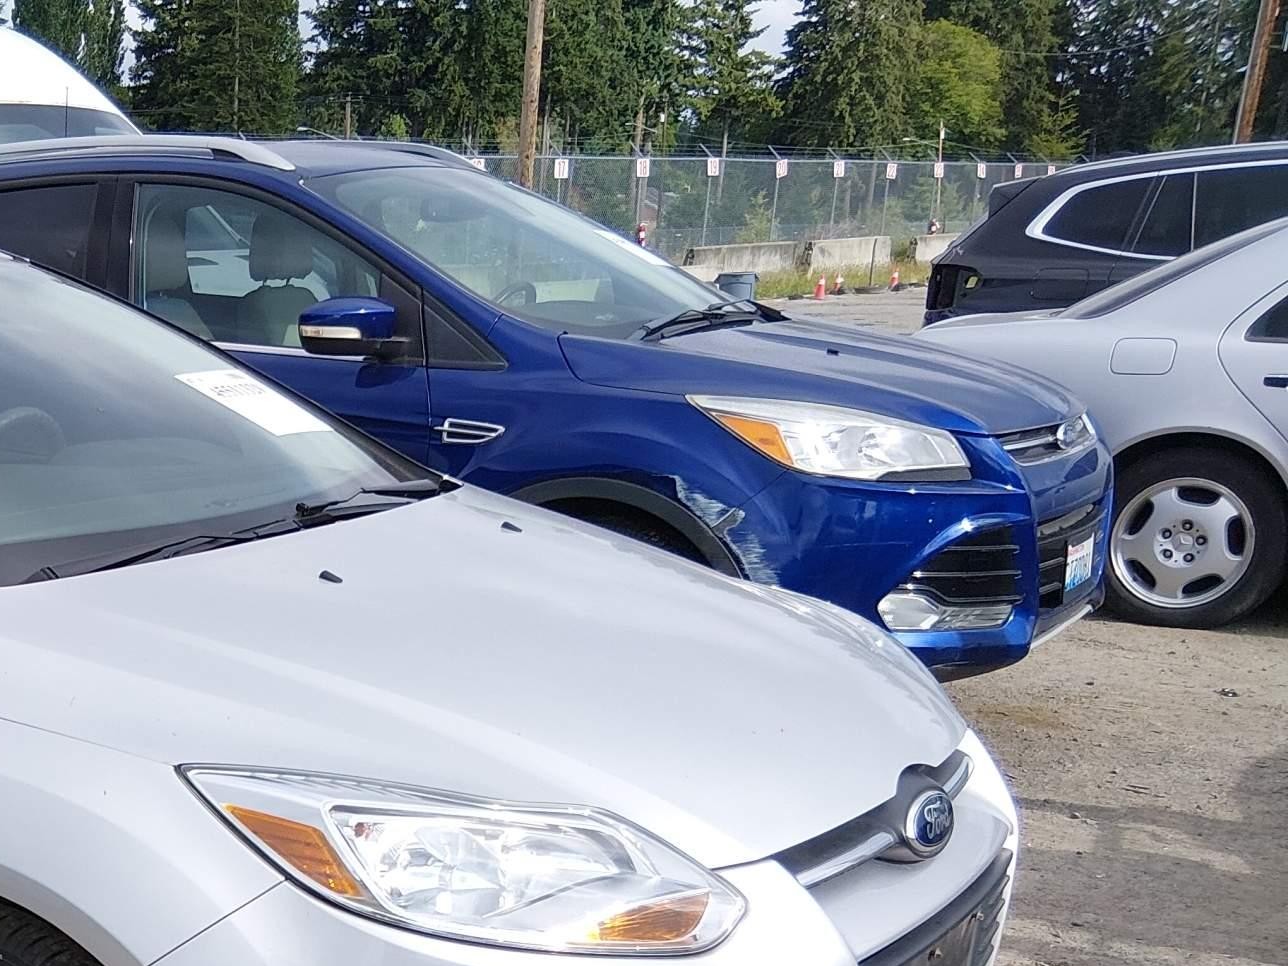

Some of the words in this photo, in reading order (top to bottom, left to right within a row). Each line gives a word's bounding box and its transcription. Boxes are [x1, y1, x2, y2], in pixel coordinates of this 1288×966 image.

[558, 160, 566, 177] 17
[639, 160, 648, 176] 18
[709, 159, 718, 174] 19
[923, 800, 951, 840] Ford
